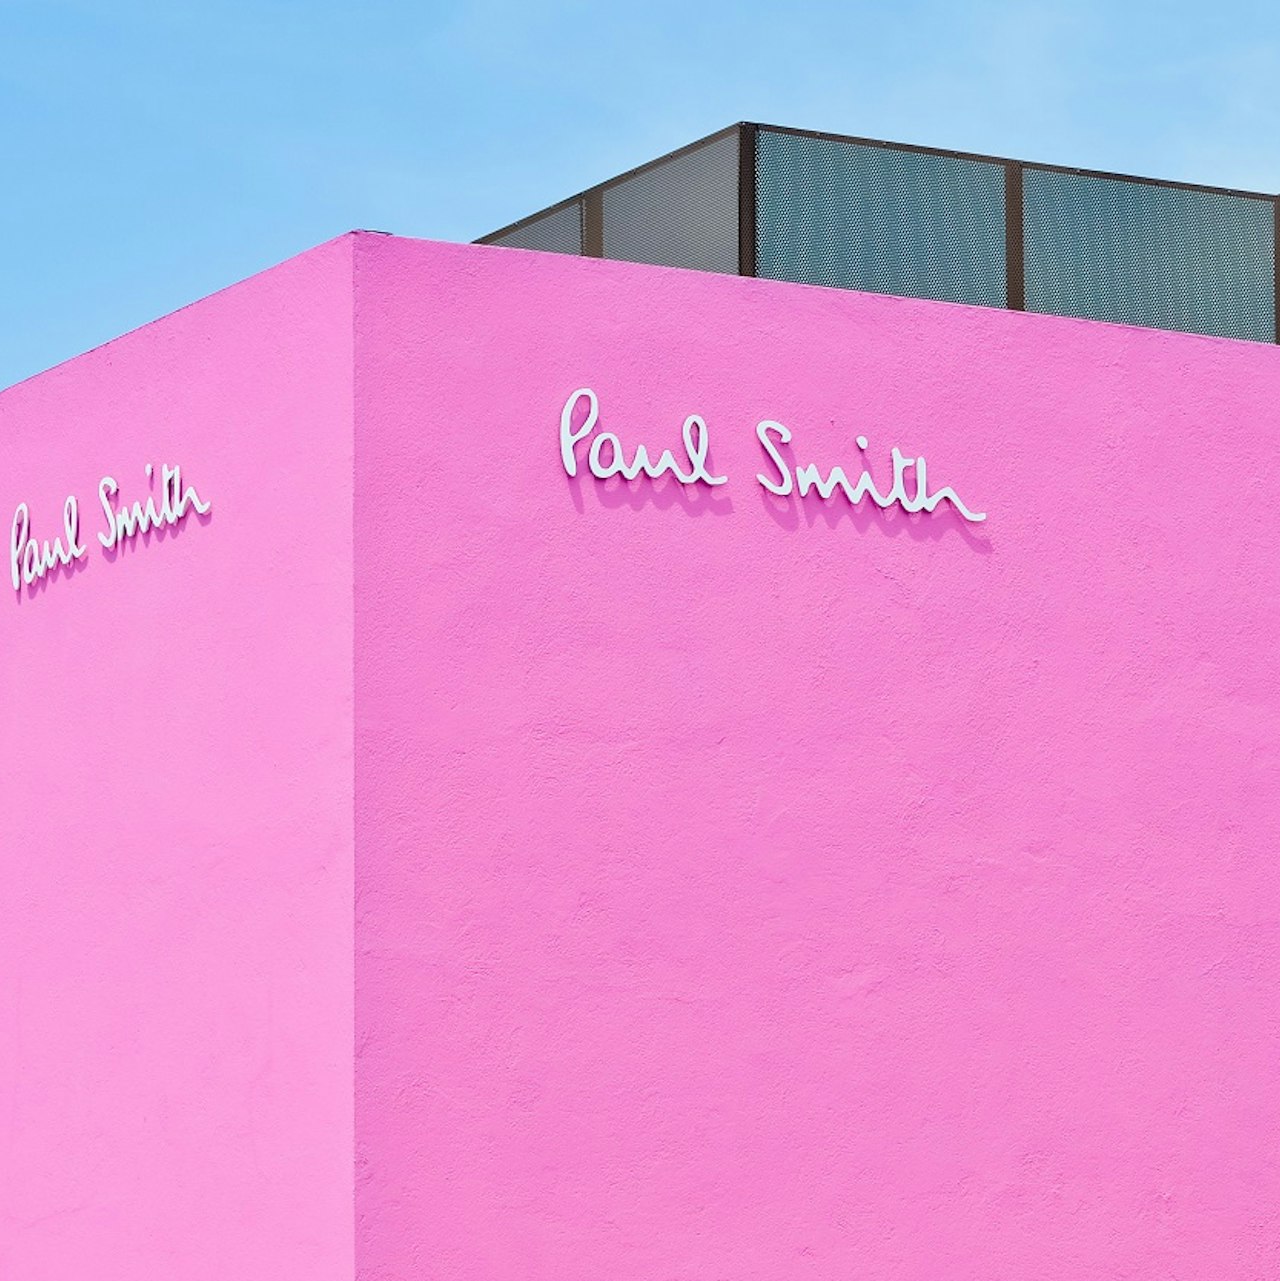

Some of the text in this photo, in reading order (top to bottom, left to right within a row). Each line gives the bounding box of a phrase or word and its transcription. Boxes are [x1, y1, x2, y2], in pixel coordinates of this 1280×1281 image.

[560, 388, 987, 522] Paul Smith
[10, 463, 212, 590] Paul Smith
